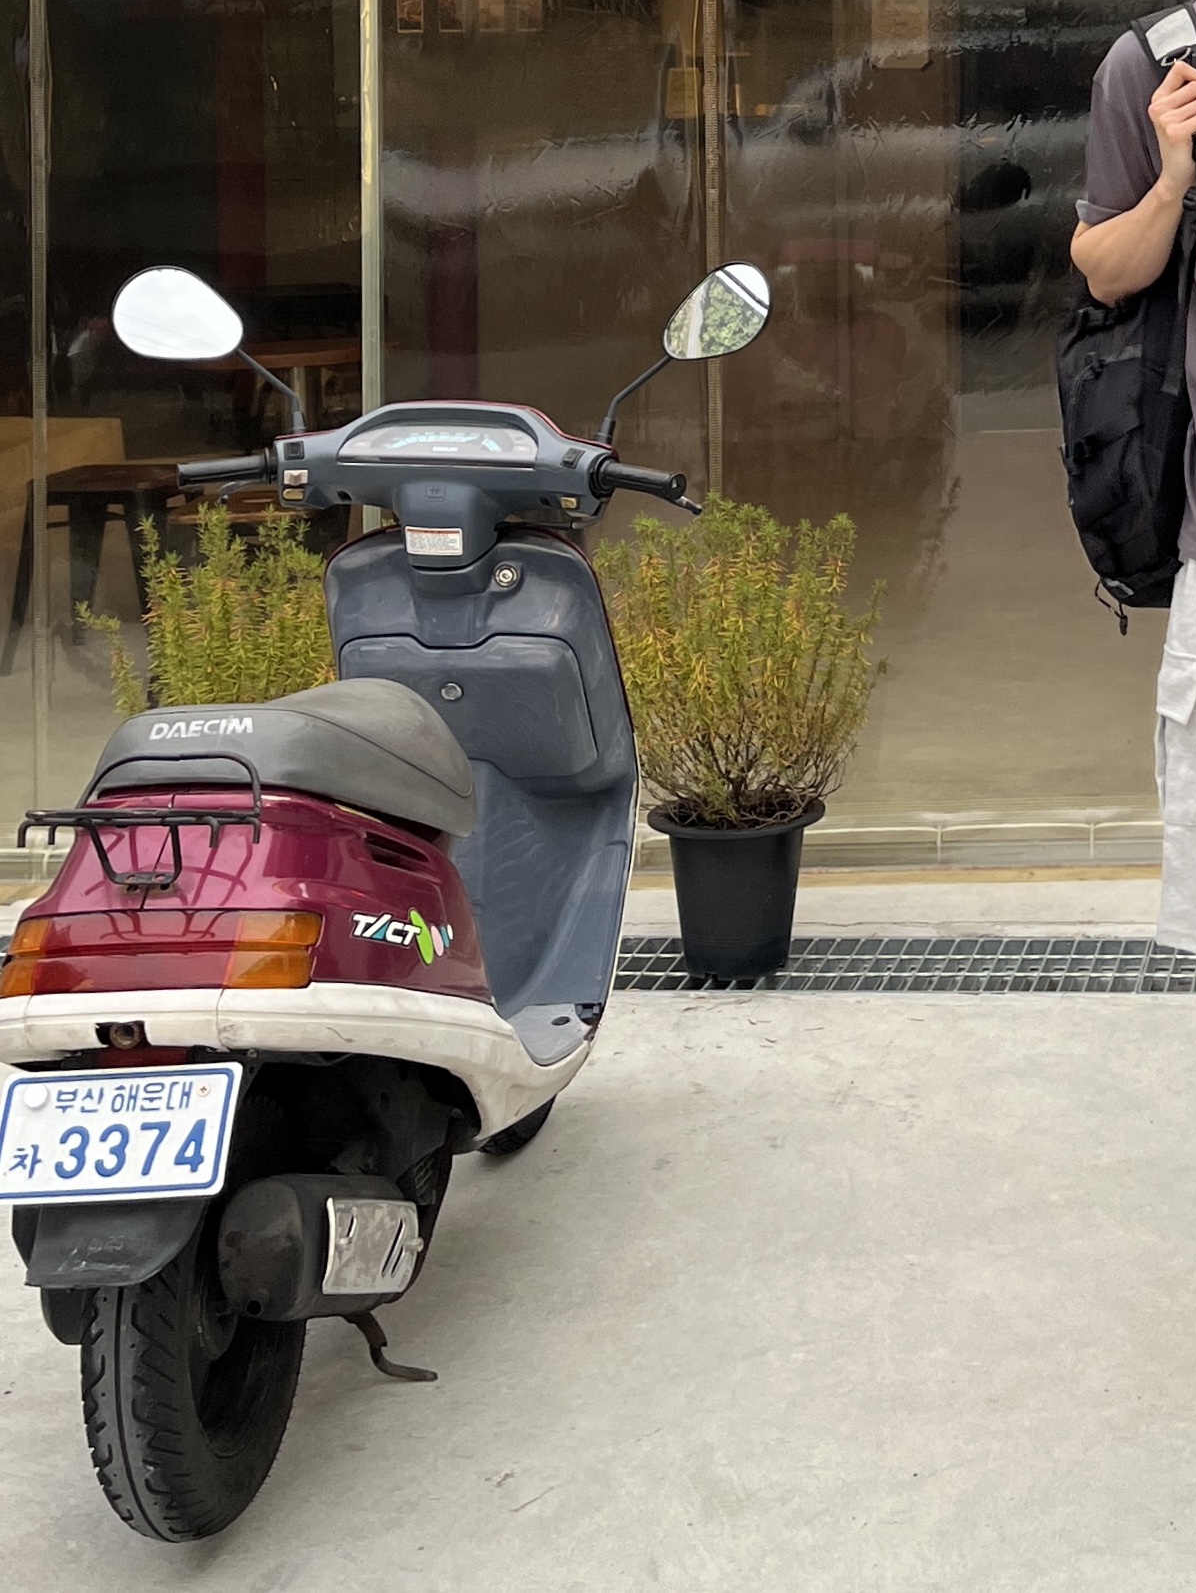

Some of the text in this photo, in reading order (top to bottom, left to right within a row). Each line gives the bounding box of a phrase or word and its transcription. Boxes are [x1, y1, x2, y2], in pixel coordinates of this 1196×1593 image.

[352, 913, 422, 946] TACT
[55, 1080, 194, 1114] 부산 해운대
[8, 1117, 208, 1180] 차 3374
